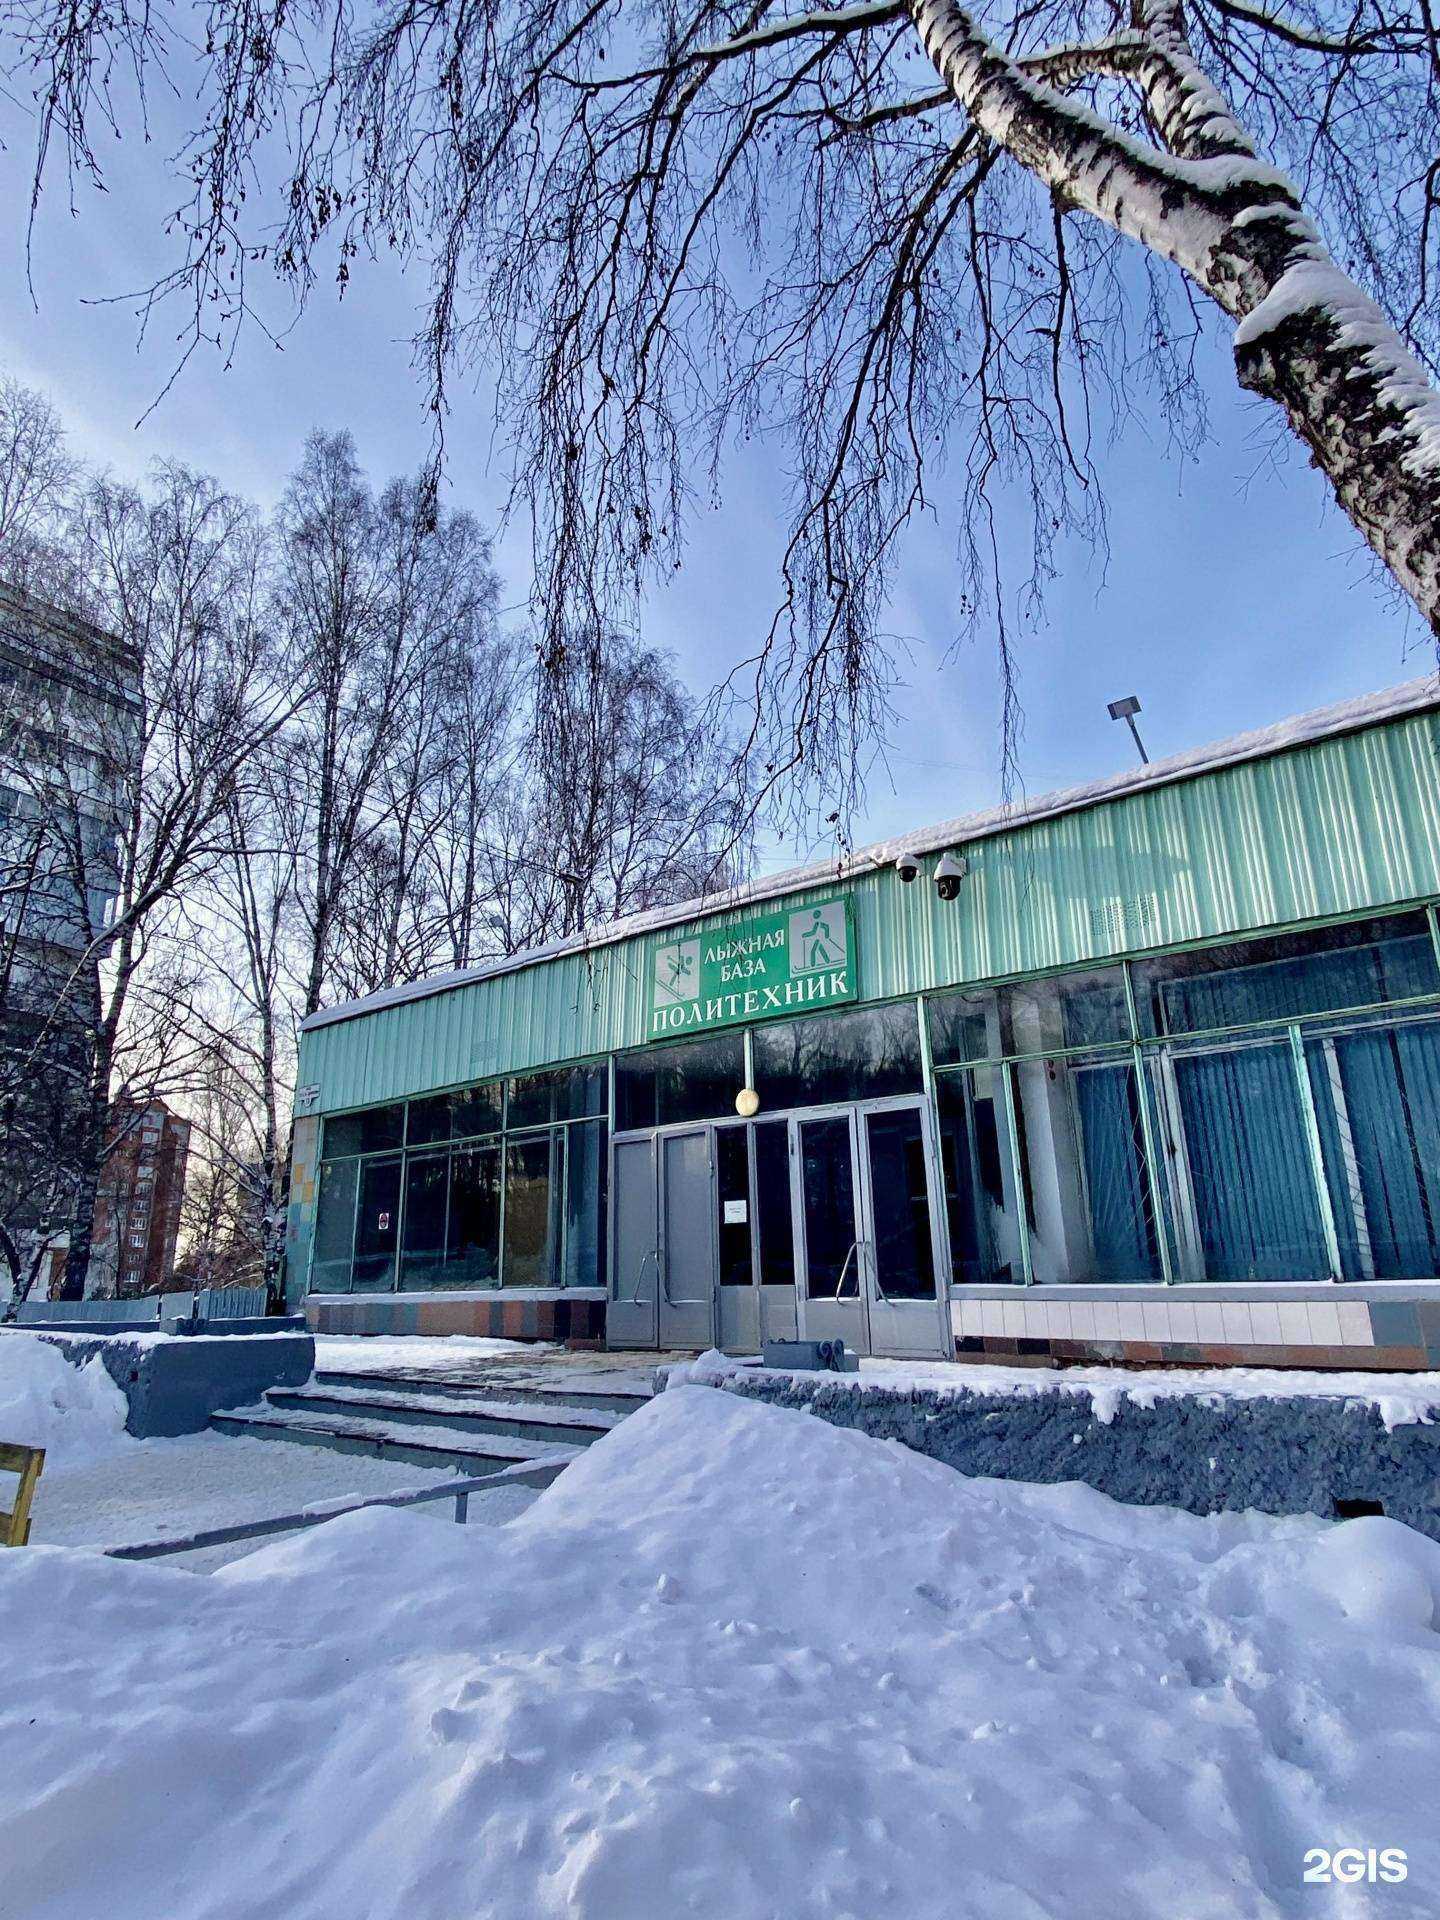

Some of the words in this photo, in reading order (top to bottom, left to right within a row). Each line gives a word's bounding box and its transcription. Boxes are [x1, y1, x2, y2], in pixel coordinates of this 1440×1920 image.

[704, 929, 785, 965] ЛЫЖНАЯ
[721, 957, 766, 982] БАЗА
[653, 970, 849, 1032] ПОЛИТЕХНИК
